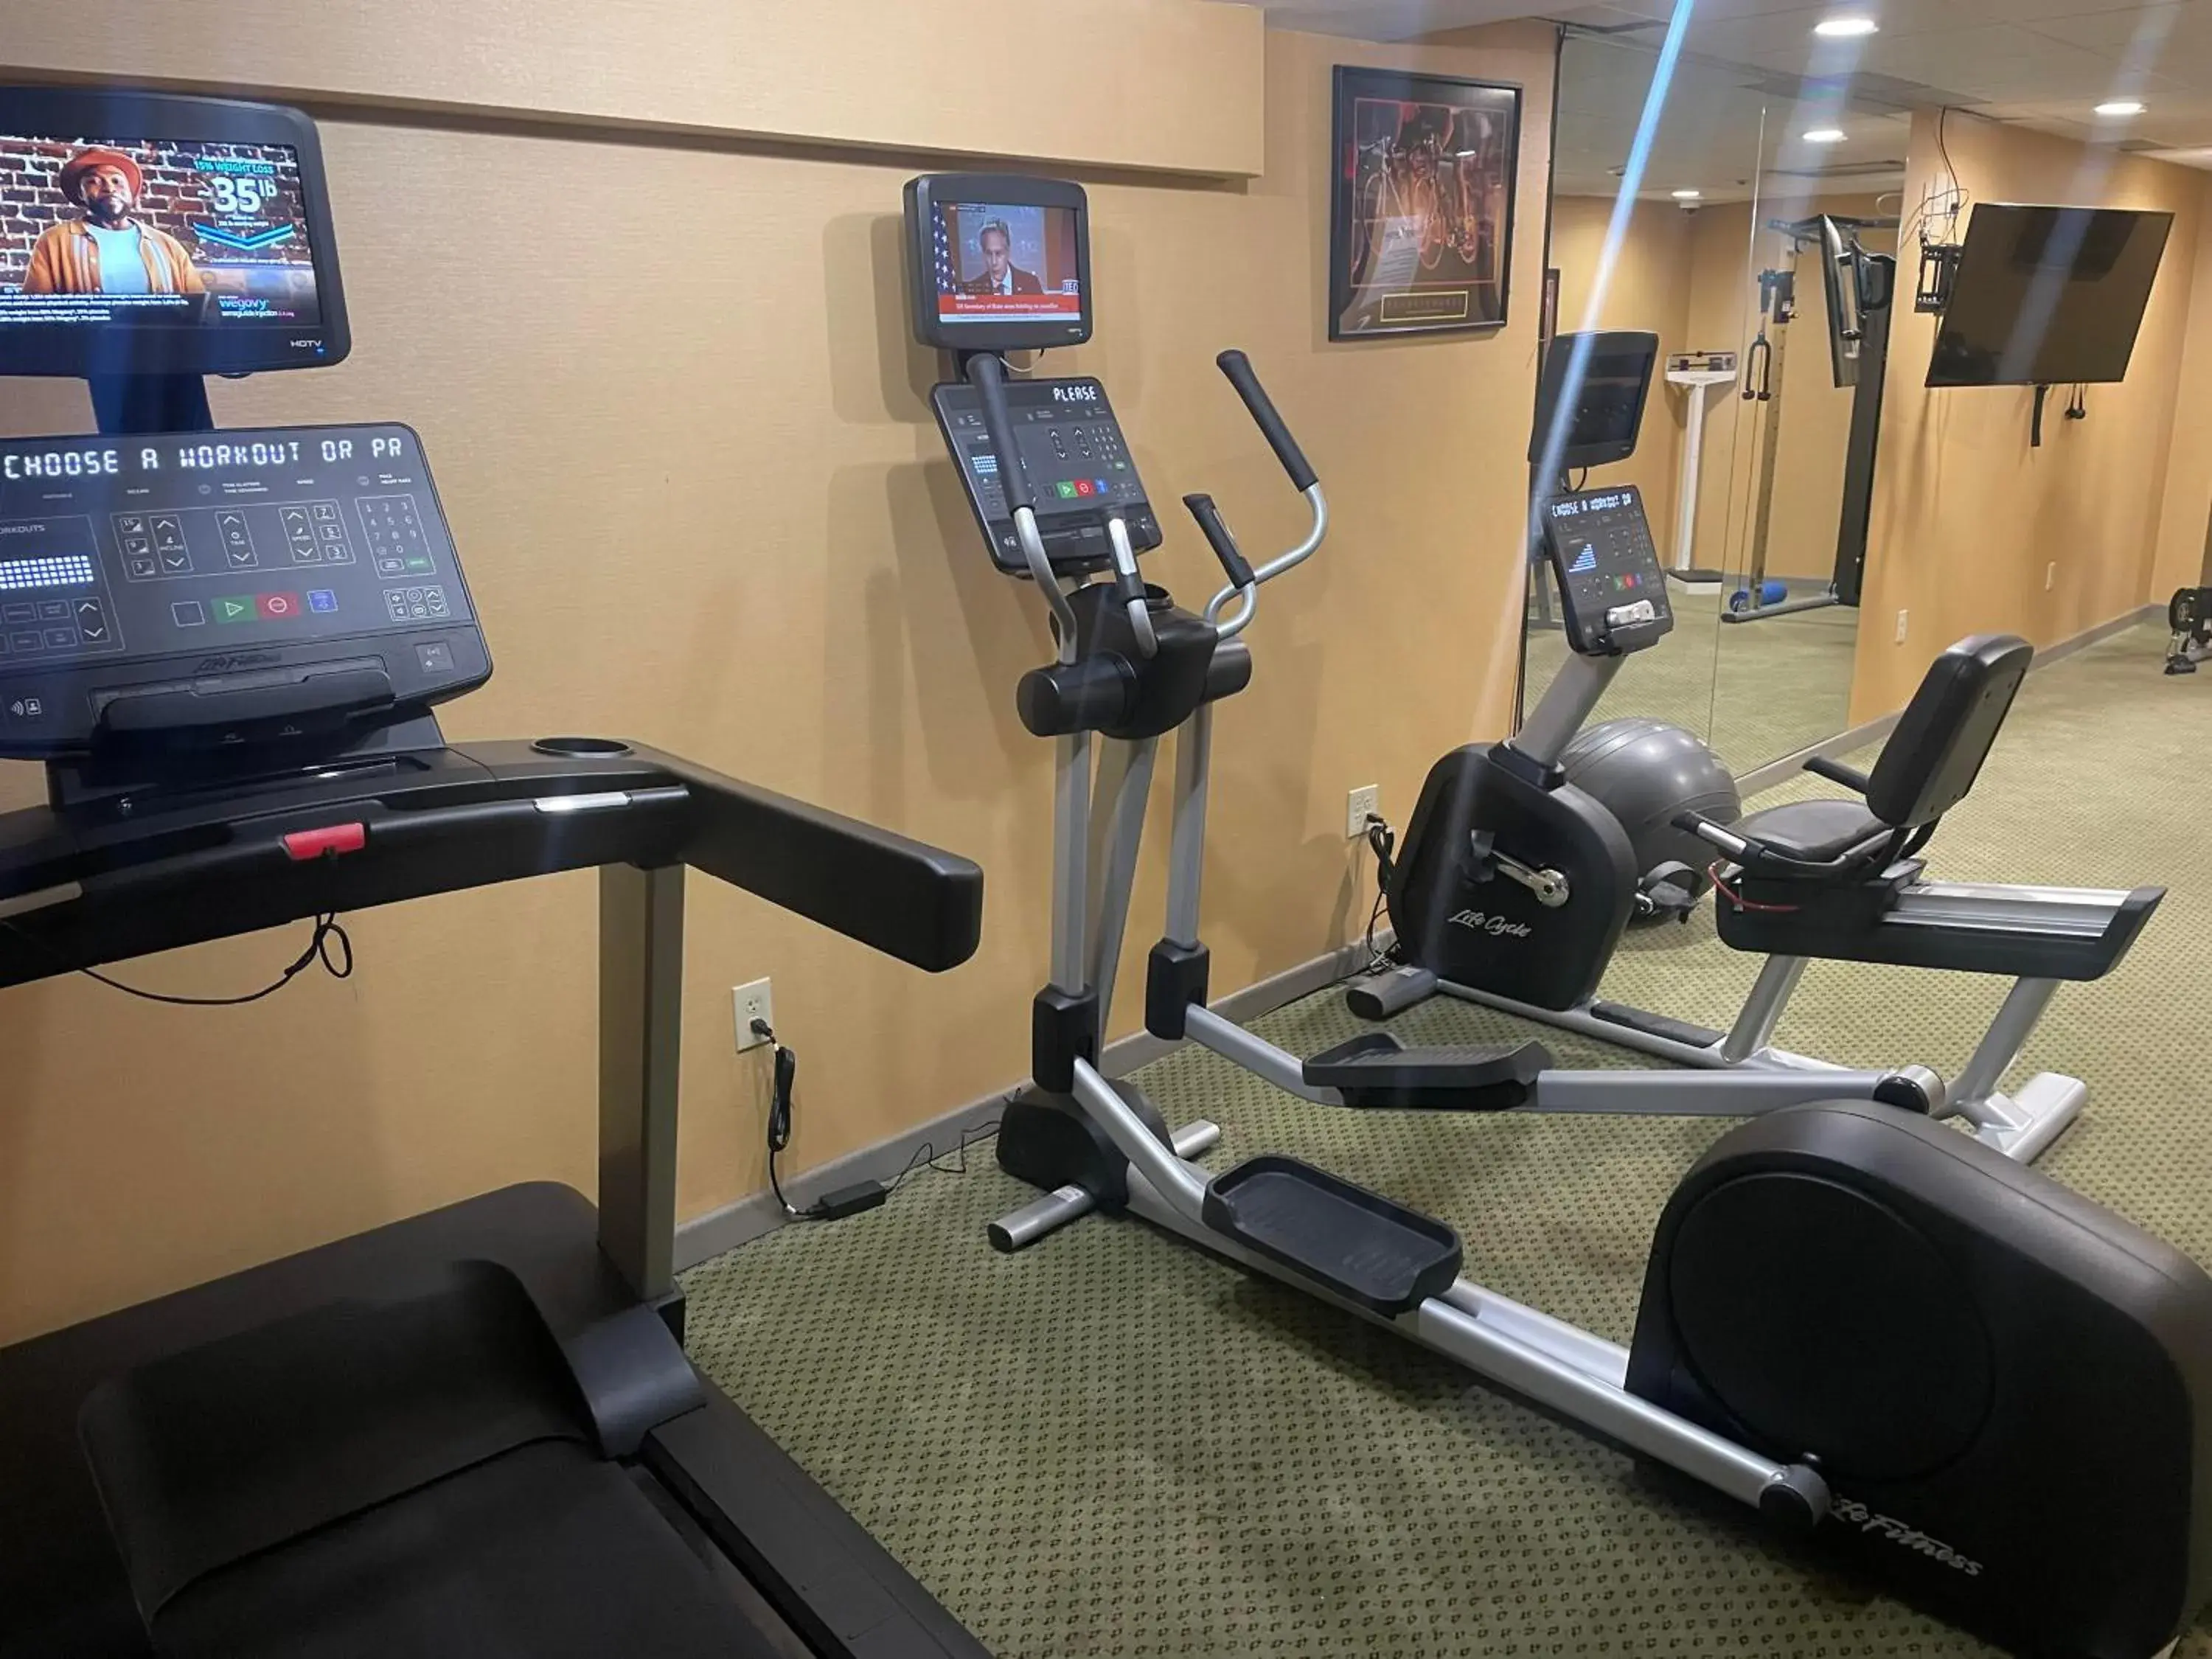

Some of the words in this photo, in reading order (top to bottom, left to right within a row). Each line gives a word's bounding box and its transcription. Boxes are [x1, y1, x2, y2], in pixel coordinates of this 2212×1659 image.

[291, 339, 322, 347] HDTV
[1053, 386, 1097, 401] PLEASE
[4, 451, 119, 479] CHOOSE
[141, 448, 159, 470] A
[178, 441, 299, 468] WORKOUT
[321, 439, 352, 462] OR
